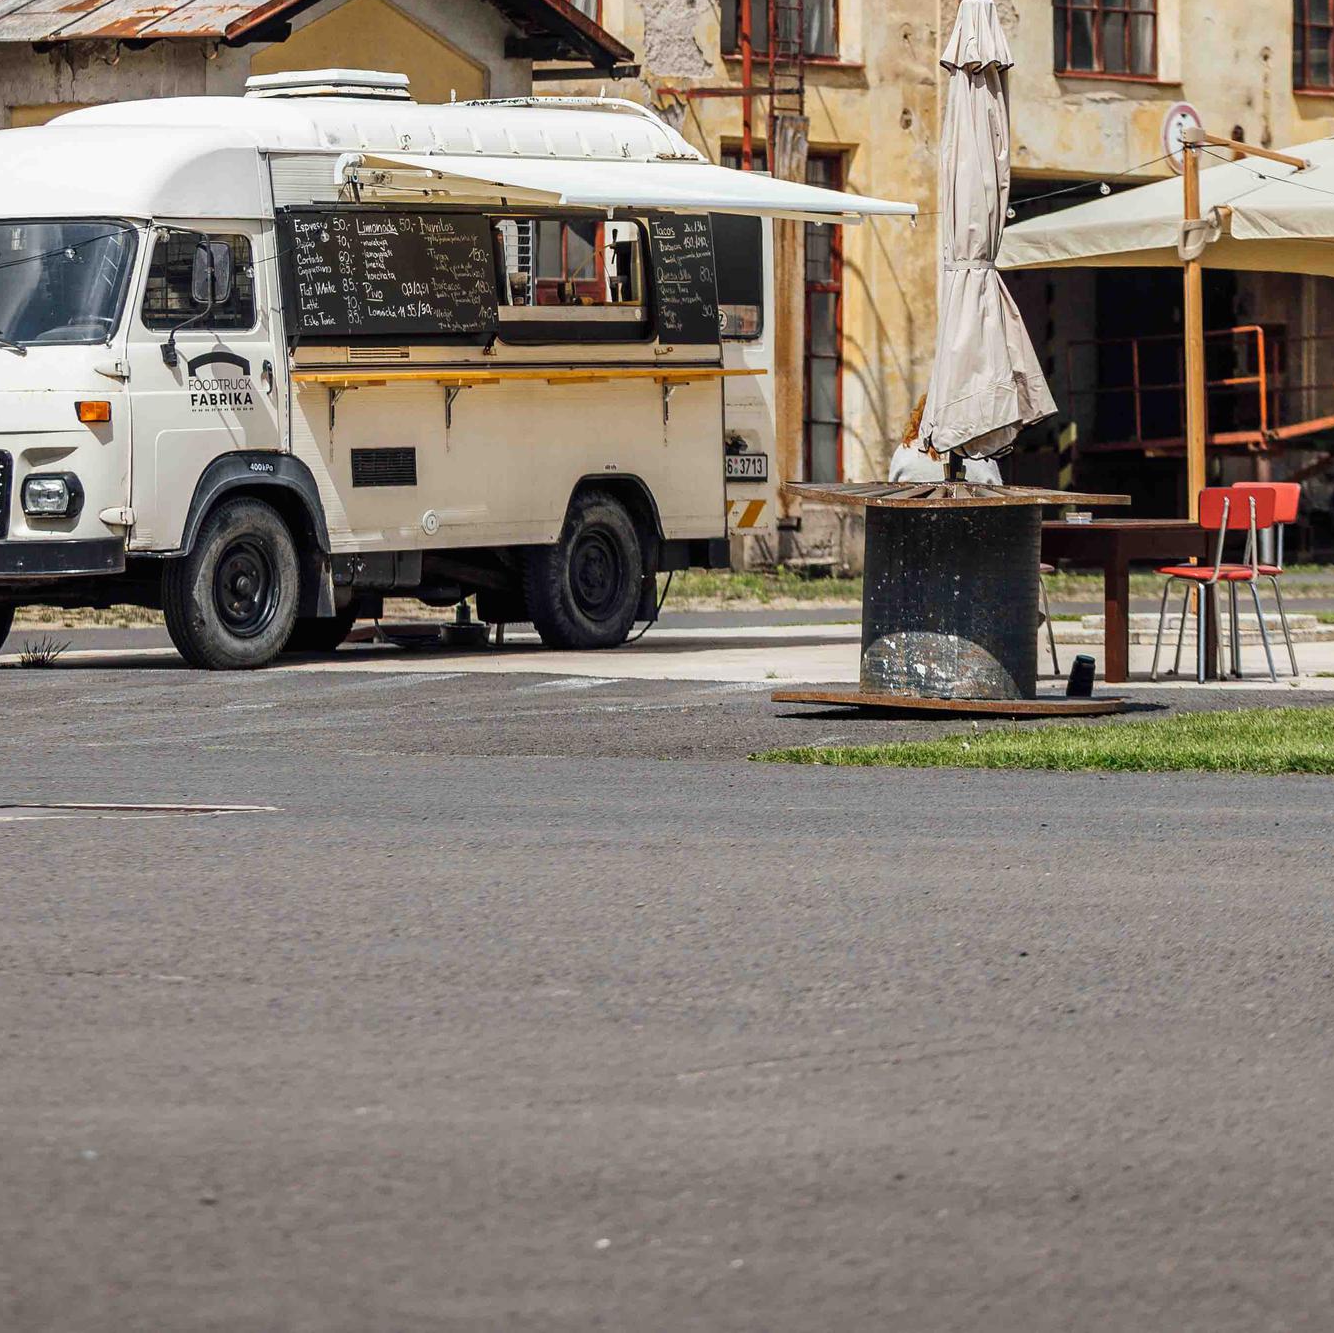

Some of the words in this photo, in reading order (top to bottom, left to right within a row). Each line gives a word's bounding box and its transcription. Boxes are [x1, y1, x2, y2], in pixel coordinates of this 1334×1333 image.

[294, 219, 328, 239] Espresso
[652, 222, 676, 236] Tacos
[299, 283, 313, 297] Flat
[315, 281, 336, 295] White
[188, 378, 252, 391] FOODTRUCK
[191, 393, 253, 406] FABRIKA
[739, 457, 763, 475] 3713
